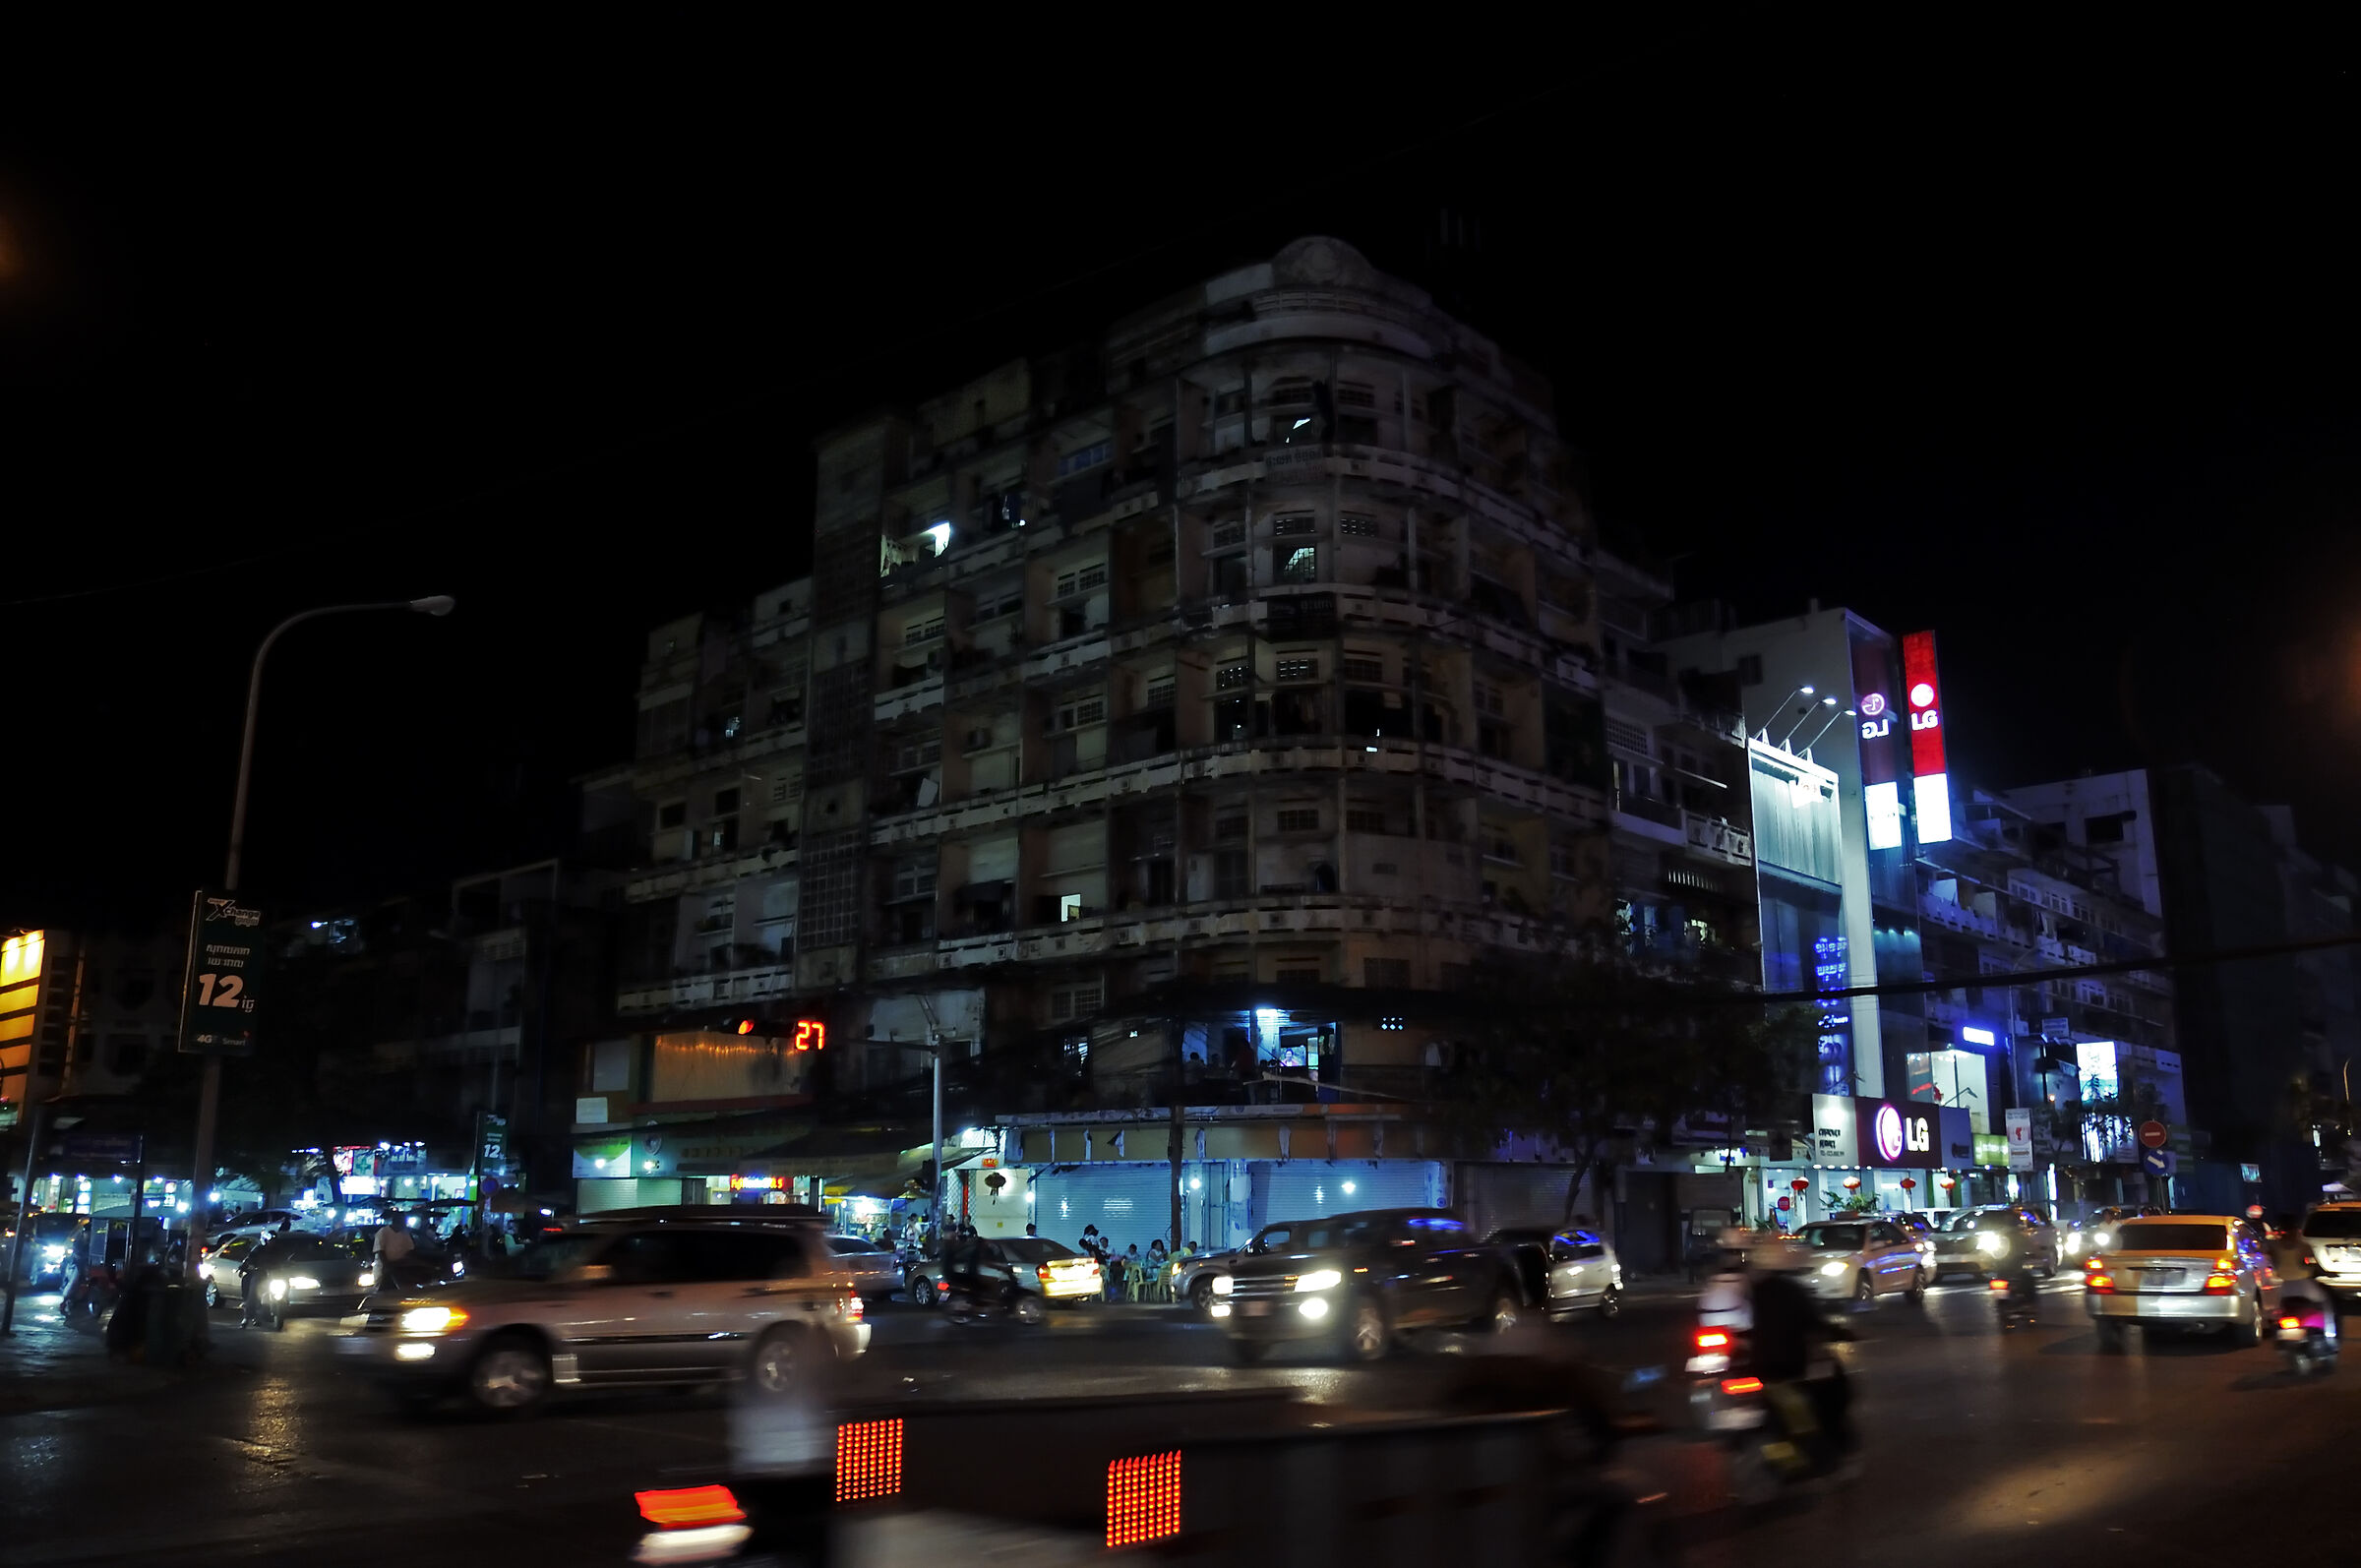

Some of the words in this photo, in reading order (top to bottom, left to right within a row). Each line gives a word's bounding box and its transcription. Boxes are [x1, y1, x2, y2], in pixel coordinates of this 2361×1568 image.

[1910, 710, 1939, 731] LG
[206, 899, 261, 921] Xchange
[198, 973, 244, 1008] 12
[197, 1034, 212, 1044] 4G
[795, 1020, 825, 1051] 27
[1905, 1116, 1930, 1152] LG
[484, 1143, 501, 1159] 12
